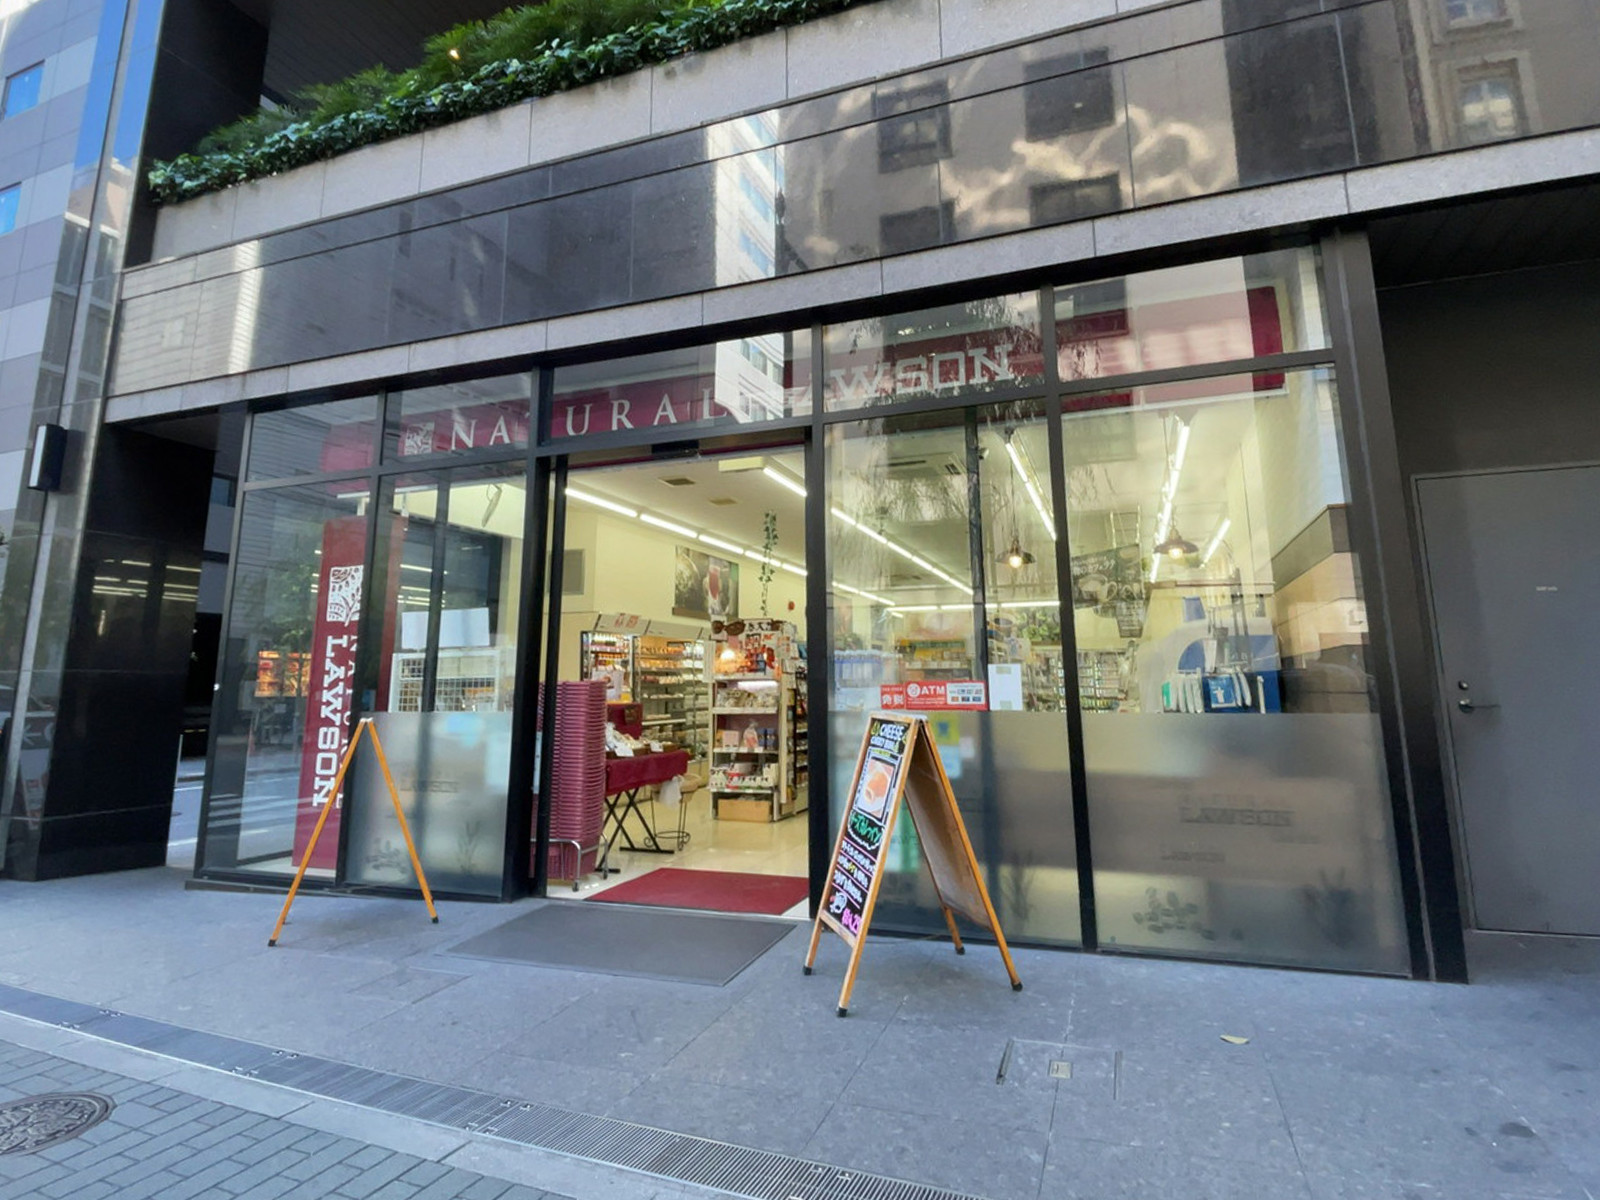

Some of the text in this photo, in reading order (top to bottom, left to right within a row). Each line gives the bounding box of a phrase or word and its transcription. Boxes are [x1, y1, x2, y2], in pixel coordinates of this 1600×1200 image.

[450, 386, 728, 451] NAURAL
[312, 634, 348, 808] LAWSON
[921, 685, 946, 696] ATM
